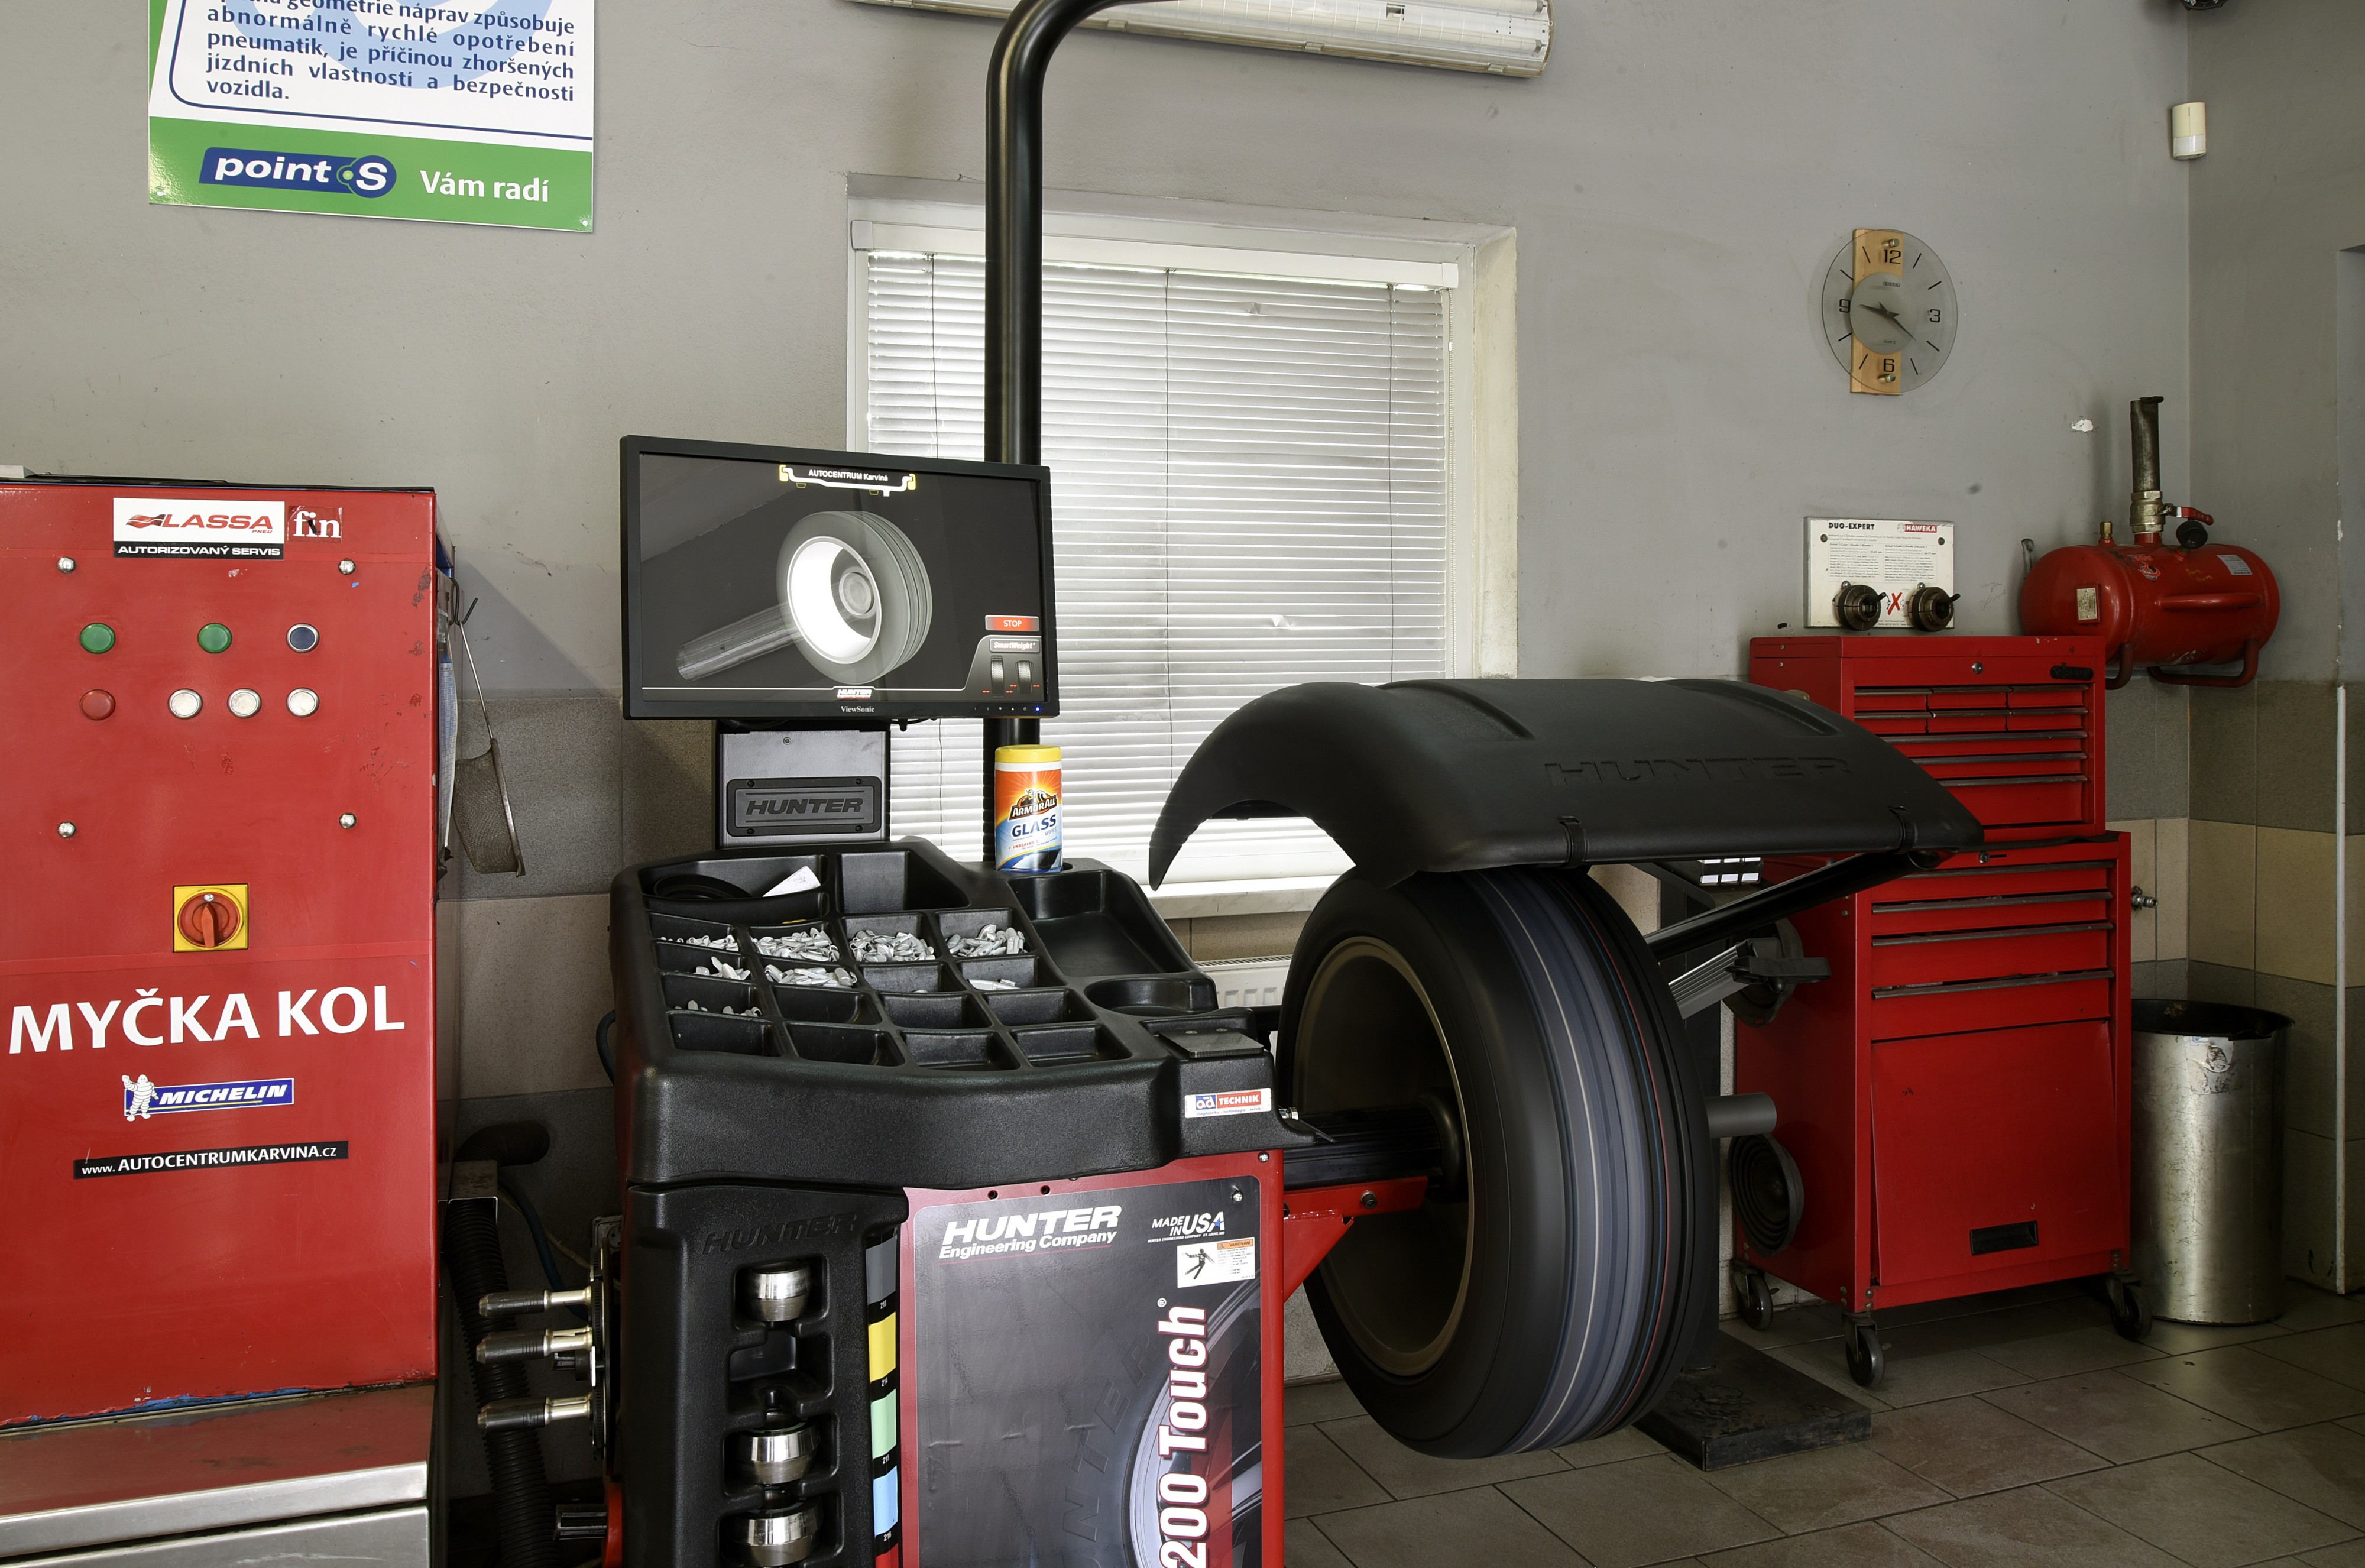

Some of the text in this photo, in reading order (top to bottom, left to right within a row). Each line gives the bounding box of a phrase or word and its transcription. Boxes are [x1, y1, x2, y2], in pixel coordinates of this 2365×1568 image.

[207, 5, 574, 56] abnormálně rychlé opotřebení
[399, 3, 469, 23] náprav
[473, 11, 574, 37] způsobuje
[208, 33, 574, 80] pneumatik, je příčinou zhoršených
[206, 53, 574, 101] jízdních vlastností a bezpečnosti
[206, 79, 289, 99] vozidla.
[215, 156, 388, 190] point S
[419, 170, 549, 202] Vám radí
[1883, 249, 1901, 264] 12
[1839, 299, 1851, 313] 9
[1929, 309, 1940, 323] 3
[1883, 358, 1895, 372] 6
[808, 469, 862, 480] AUTOCENTRUM
[162, 514, 273, 529] LASSA
[118, 545, 280, 556] AUTORIZOVANÝ SERVIS
[1544, 756, 1854, 788] HUNTER
[746, 798, 863, 815] HUNTER
[1012, 814, 1056, 837] GLASS
[1045, 828, 1057, 836] WIPES
[9, 985, 406, 1054] MYČKA KOL
[158, 1084, 288, 1106] MICHELIN
[1219, 1095, 1259, 1105] TECHNIK
[702, 1212, 858, 1255] HUNTER
[942, 1205, 1122, 1245] HUNTER
[1152, 1216, 1185, 1229] MADE
[1169, 1211, 1225, 1236] IN USA
[939, 1231, 1117, 1259] Engineering Company
[883, 1530, 892, 1542] 216
